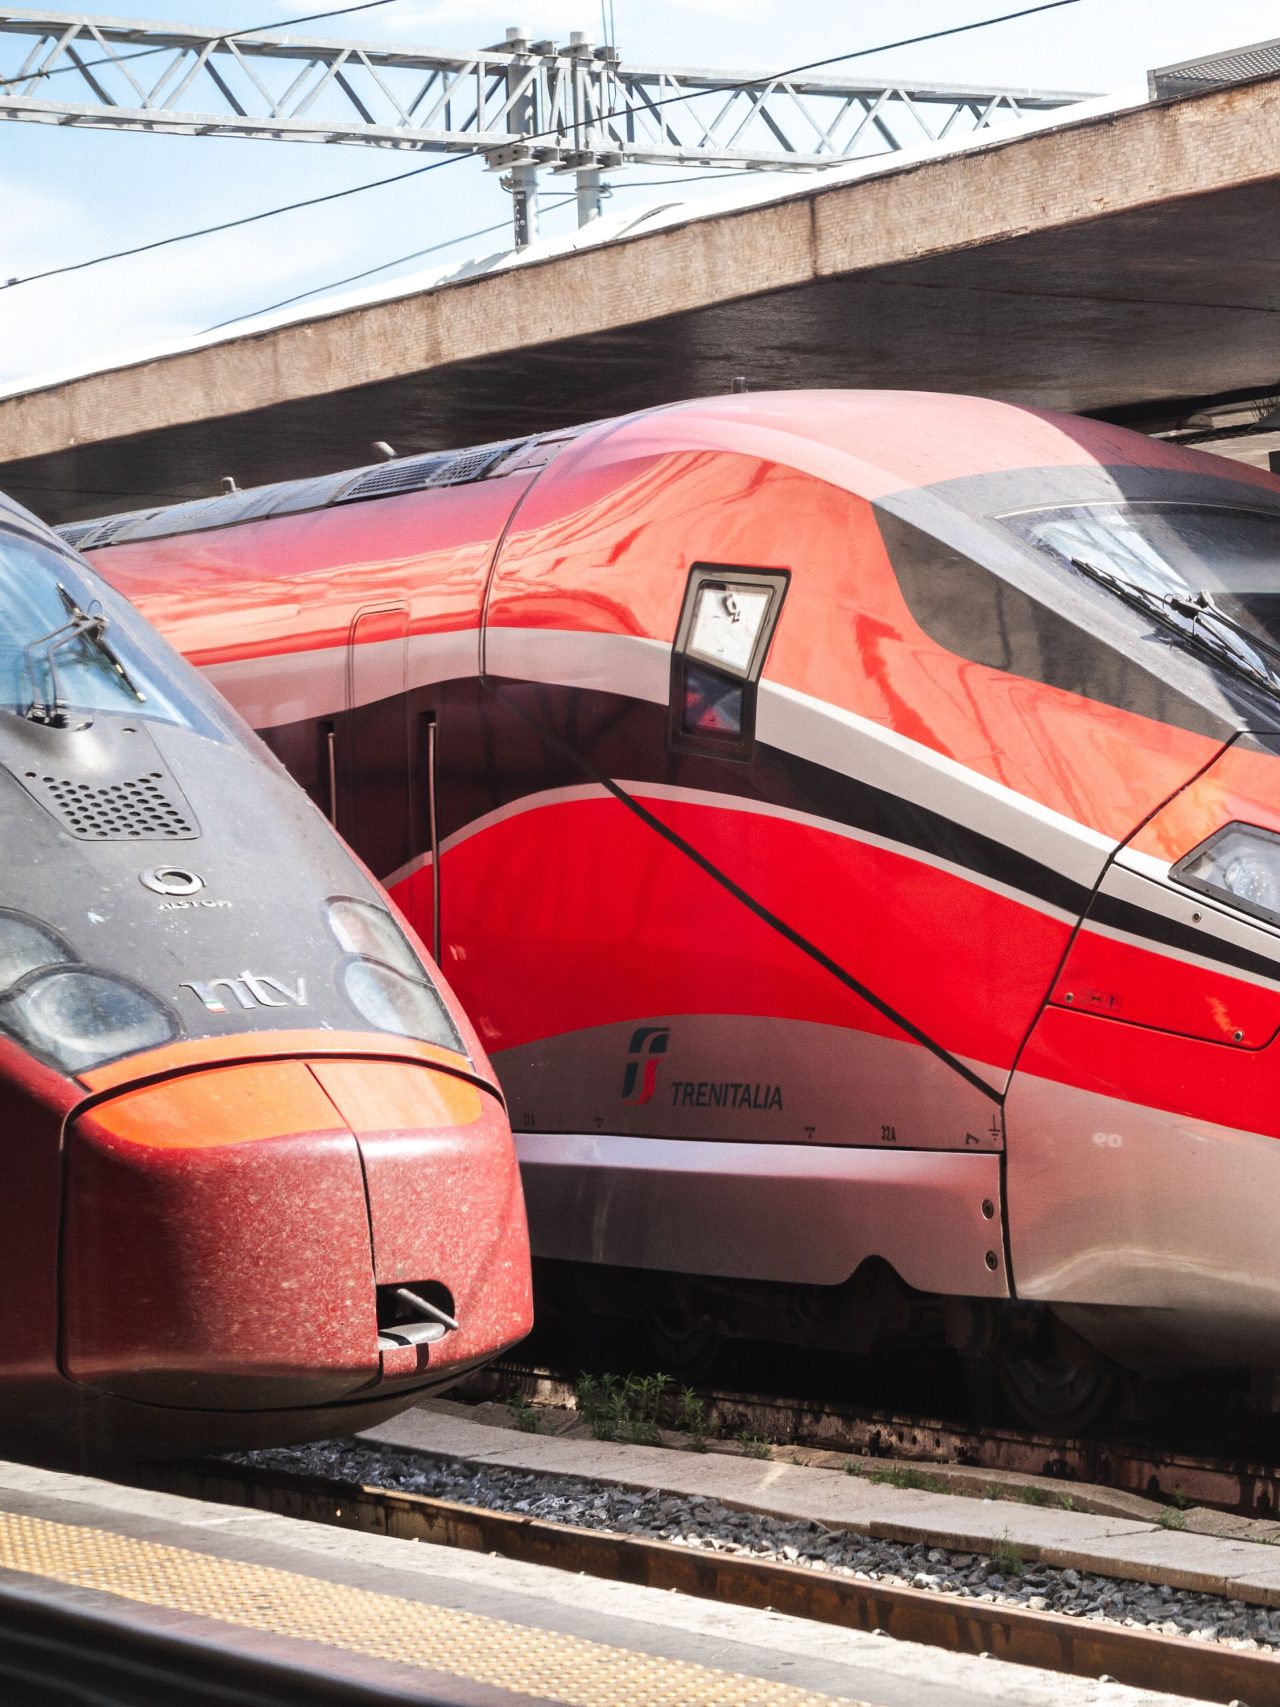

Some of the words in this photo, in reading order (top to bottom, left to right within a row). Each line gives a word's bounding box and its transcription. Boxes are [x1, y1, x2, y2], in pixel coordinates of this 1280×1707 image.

[179, 969, 308, 1013] ntv
[671, 1081, 783, 1112] TRENITALIA
[880, 1125, 897, 1142] 32A
